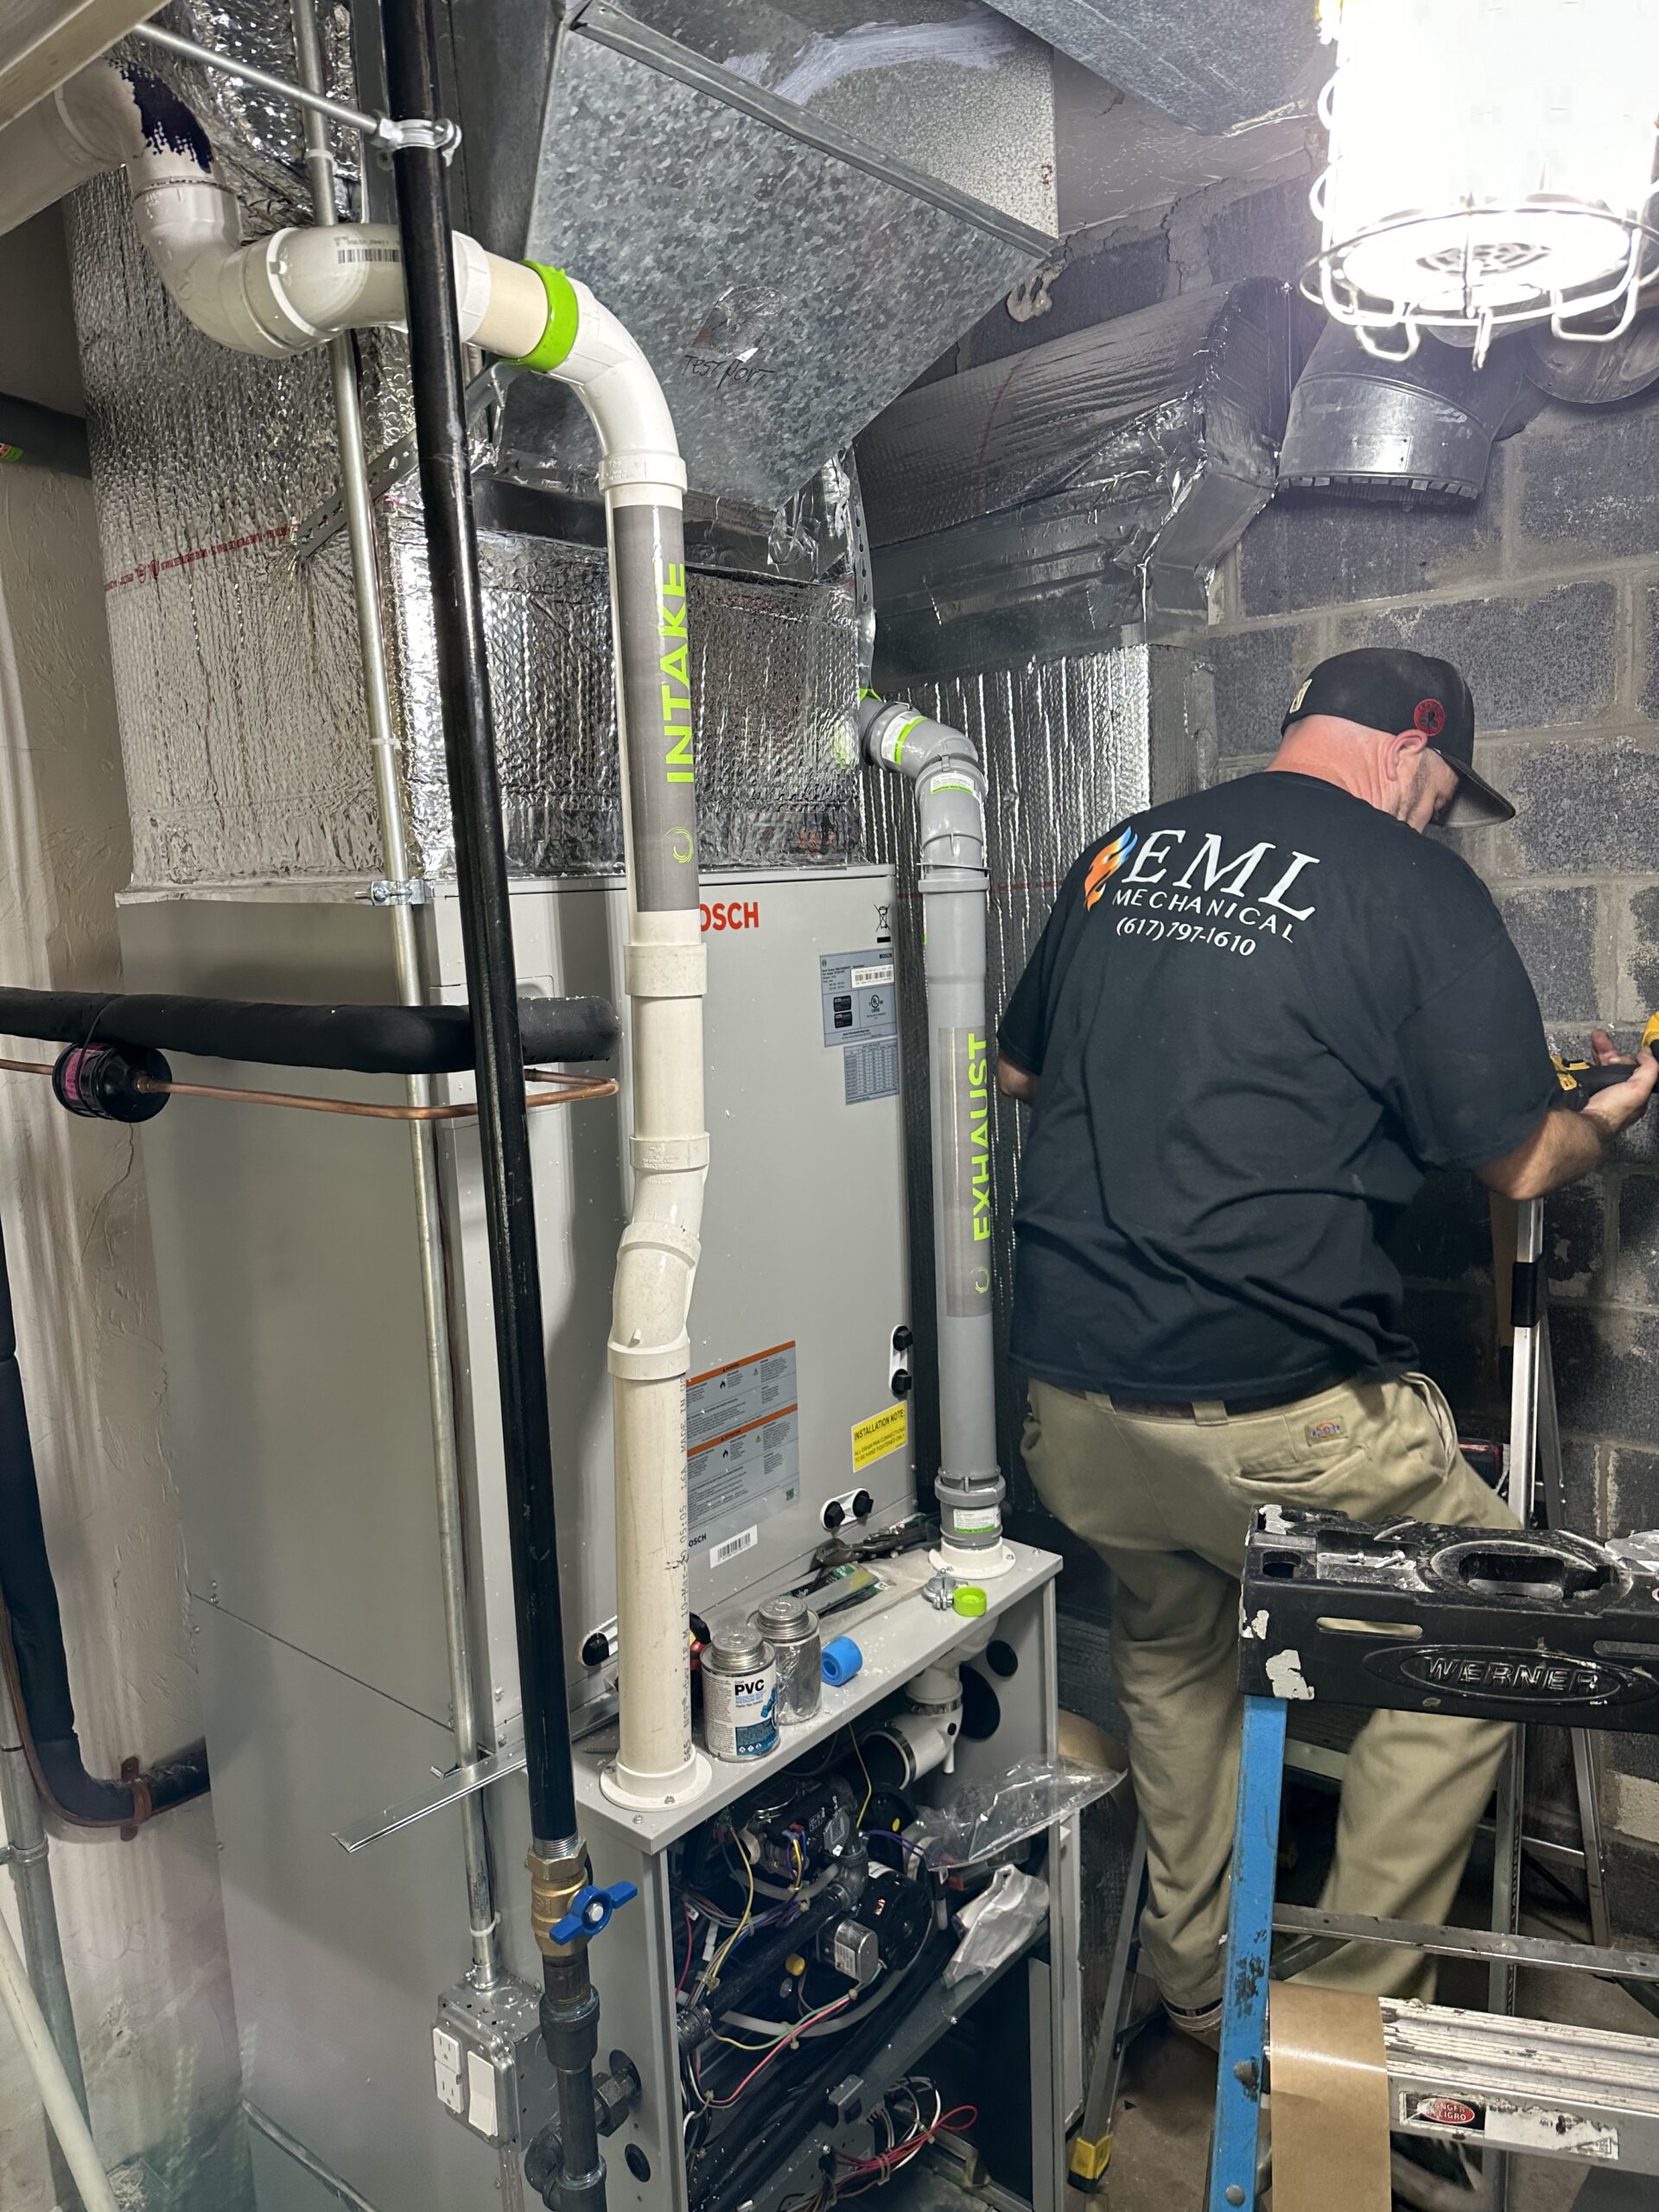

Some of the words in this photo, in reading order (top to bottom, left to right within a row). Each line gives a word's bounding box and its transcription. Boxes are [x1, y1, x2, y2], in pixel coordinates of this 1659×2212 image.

[658, 563, 695, 783] INTAKE
[1122, 830, 1320, 922] EML
[699, 902, 760, 932] OSCH
[1112, 888, 1294, 944] MECHANICAL
[968, 1033, 992, 1242] EXHAUST
[854, 1416, 890, 1441] INSTALLATION
[689, 1533, 707, 1548] OSCH
[734, 1679, 765, 1695] PVC
[1424, 1656, 1599, 1694] WERNER
